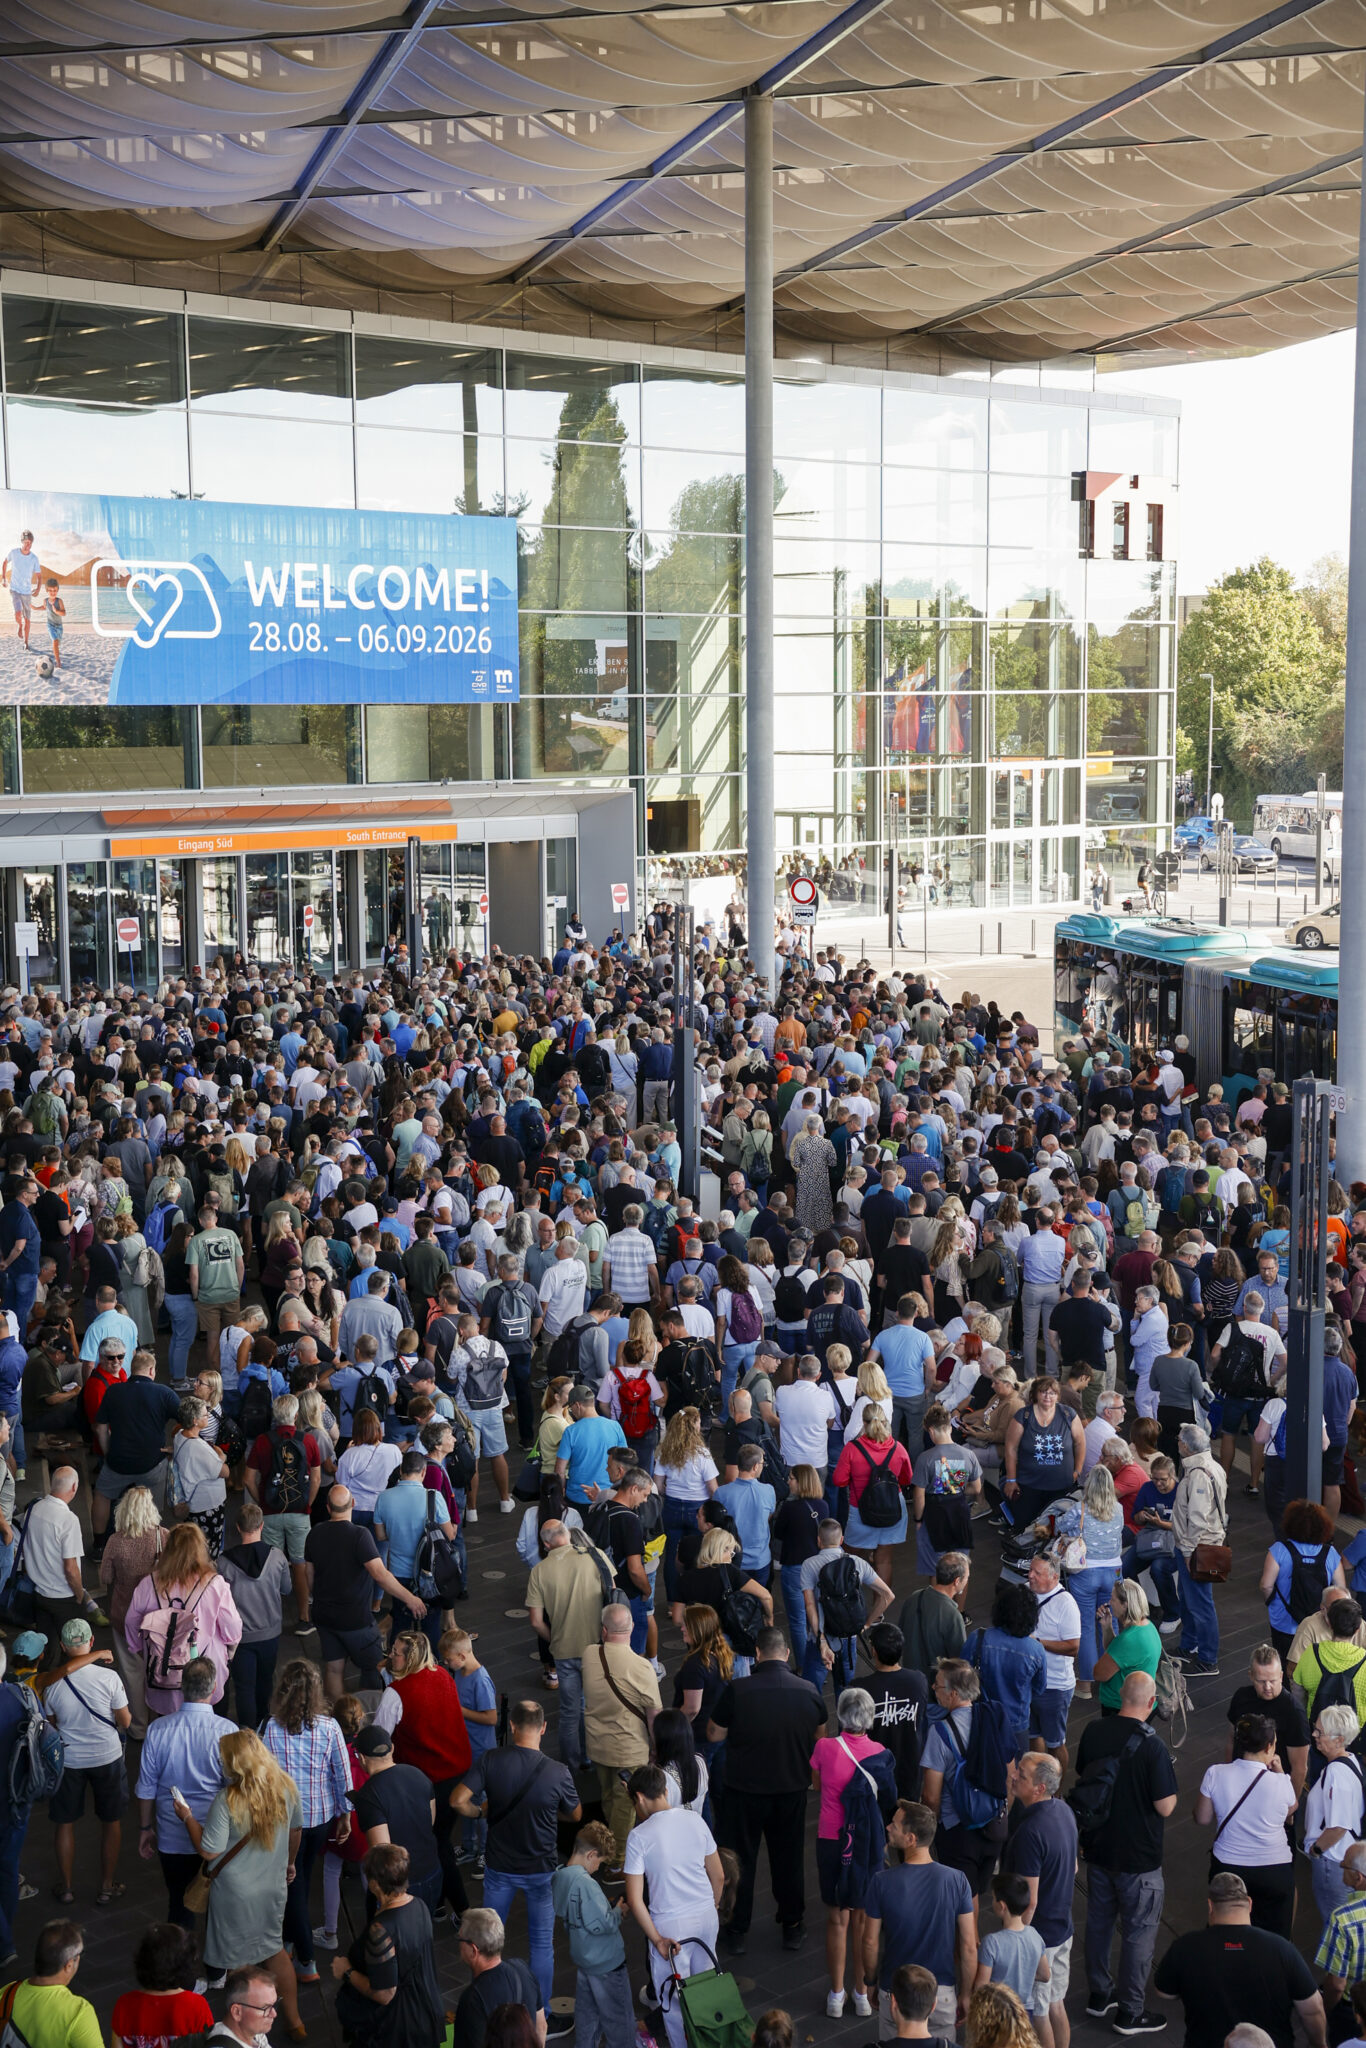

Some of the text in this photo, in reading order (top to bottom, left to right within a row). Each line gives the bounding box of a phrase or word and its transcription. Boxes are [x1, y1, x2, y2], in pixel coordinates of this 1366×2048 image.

[244, 560, 490, 613] WELCOME!
[248, 621, 329, 652] 28.08.
[358, 623, 493, 654] 06.09.2026
[178, 836, 233, 851] Eingang Süd
[346, 829, 407, 842] South Entrance
